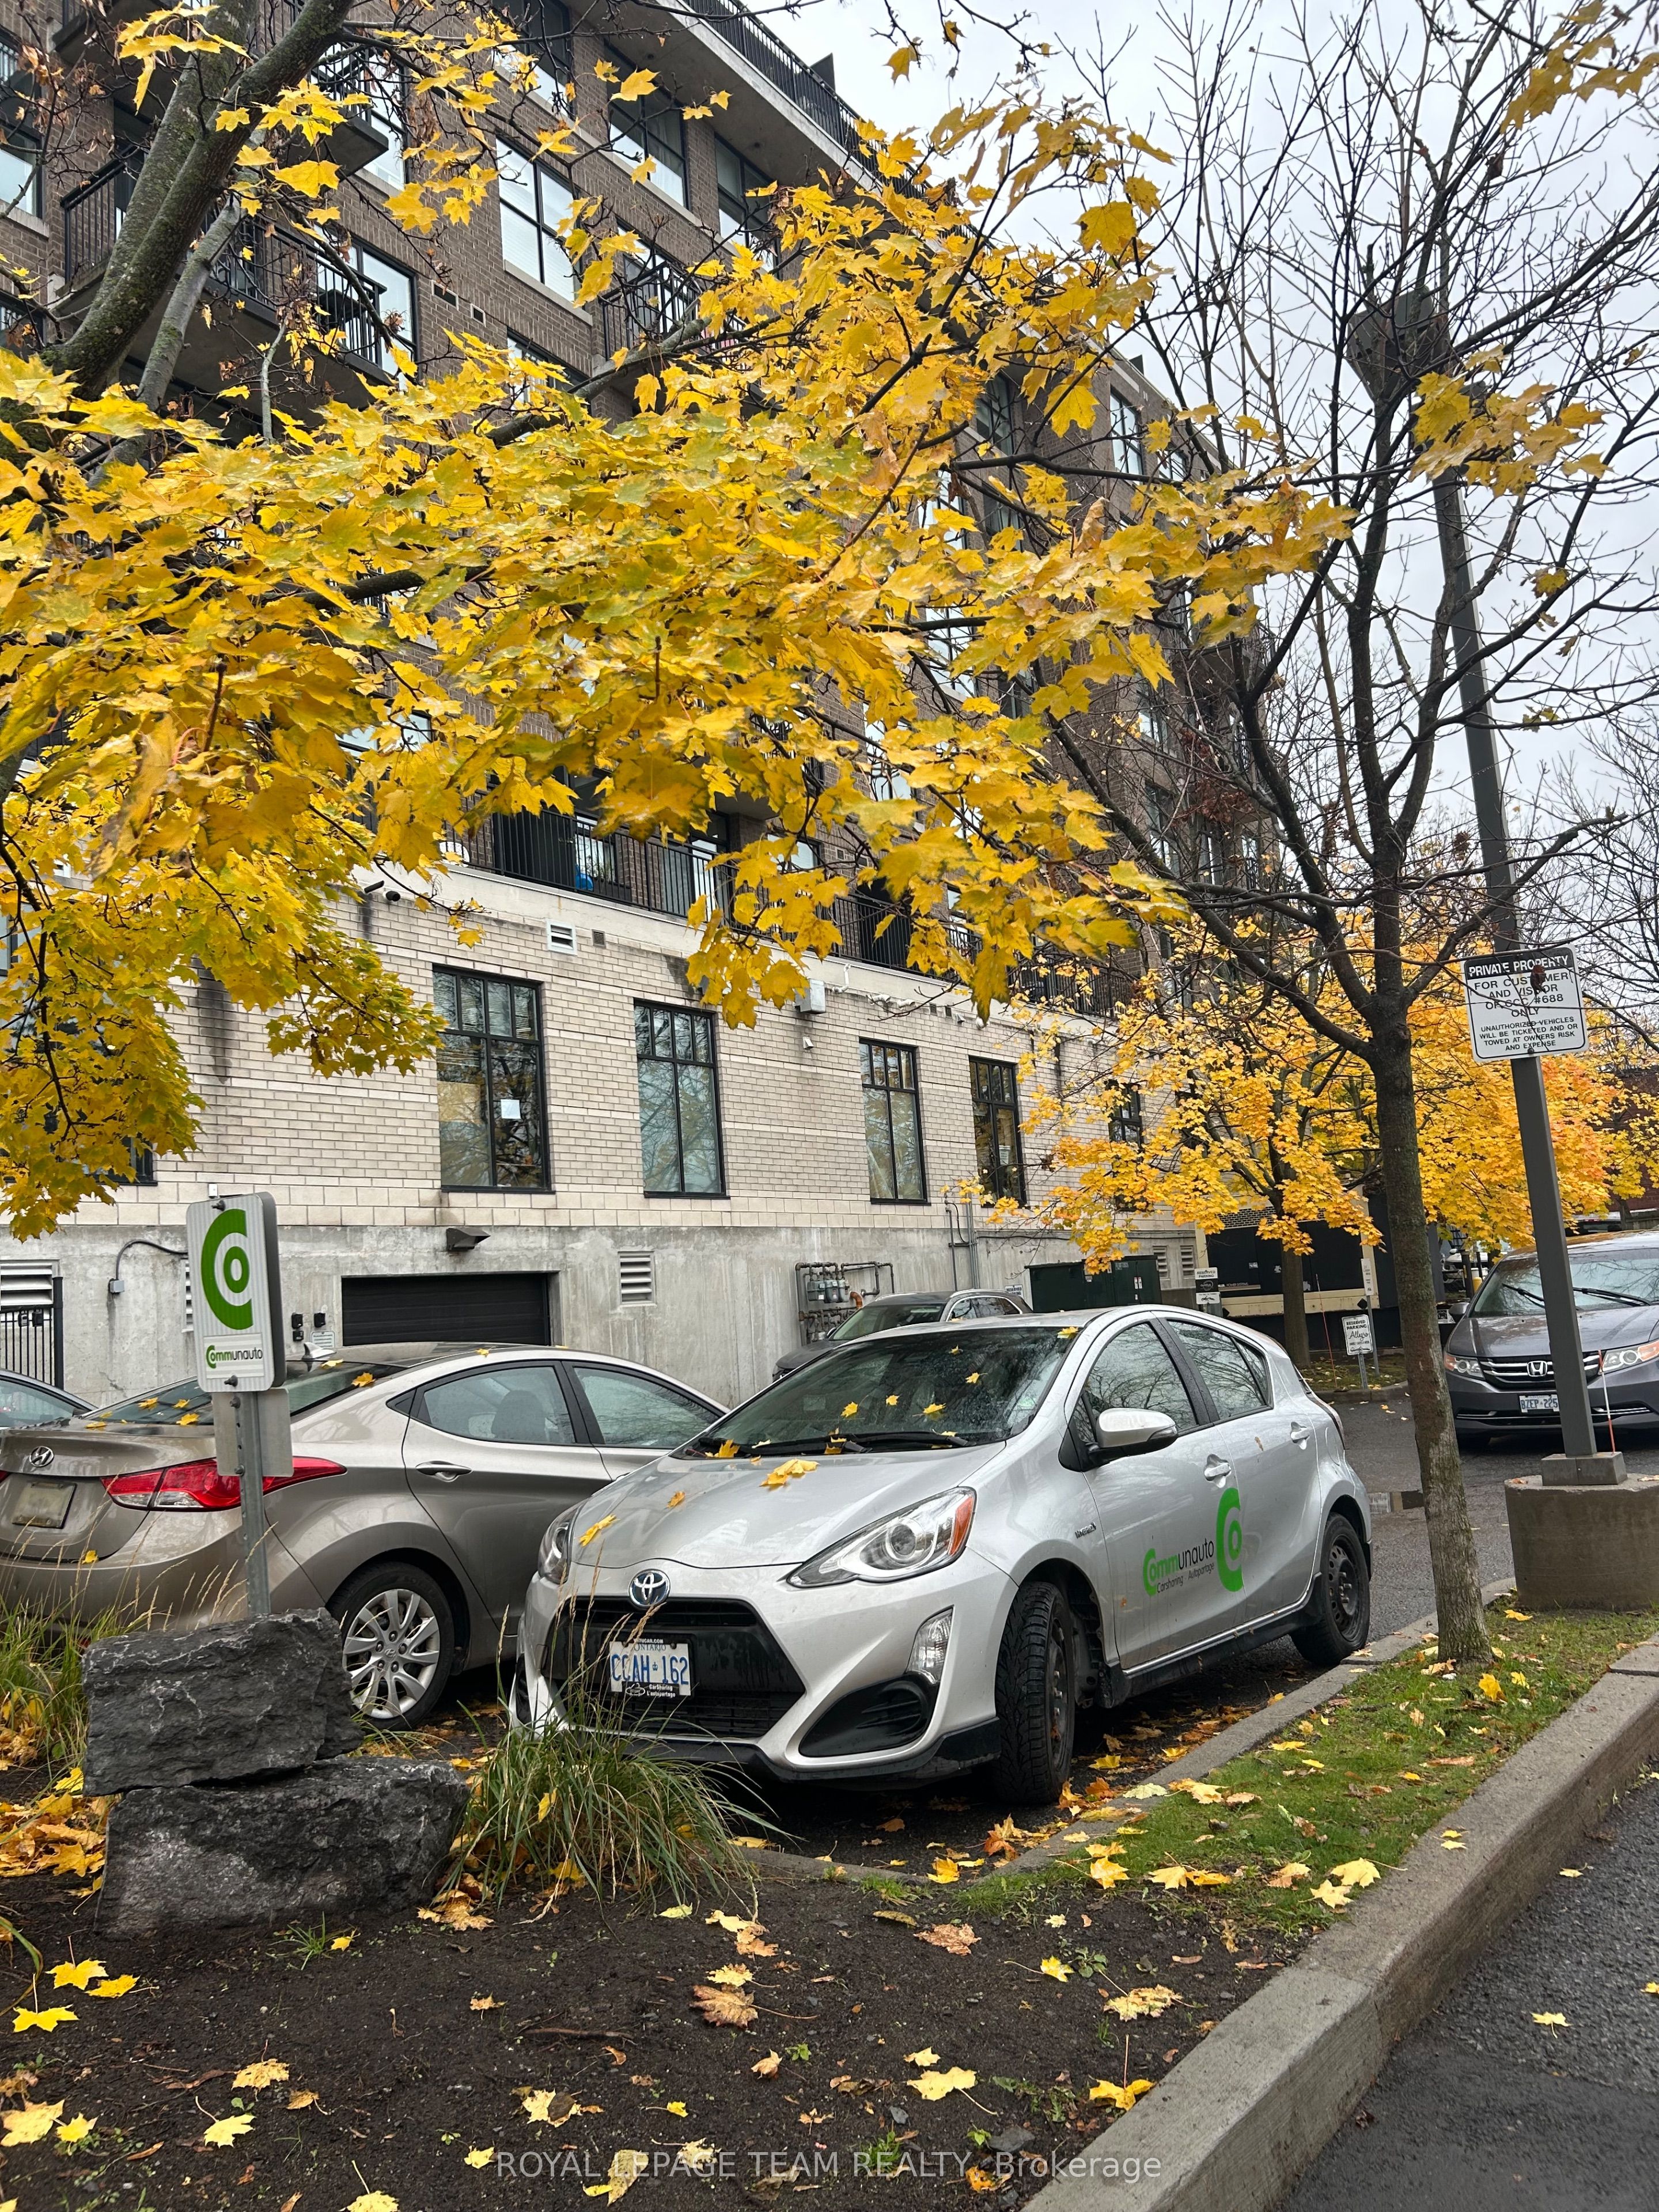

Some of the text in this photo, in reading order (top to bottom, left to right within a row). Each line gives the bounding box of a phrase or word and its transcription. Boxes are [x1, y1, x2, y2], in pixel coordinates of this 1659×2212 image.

[1469, 955, 1569, 977] PRIVATE PROPERTY
[1474, 972, 1569, 990] FOR CUSMER
[1490, 984, 1558, 998] AND VISOR
[1535, 994, 1564, 1004] #688
[1512, 1007, 1539, 1017] ONLY
[1481, 1016, 1574, 1032] UNAUTHORIZED VEHICLES
[1512, 1027, 1547, 1035] TICKETED
[1524, 1033, 1555, 1041] OWNERS
[1523, 1040, 1556, 1049] EXPENSE
[1348, 1330, 1369, 1342] Allegro
[206, 1345, 263, 1369] Communauto
[1543, 1398, 1558, 1408] 225
[1143, 1538, 1214, 1596] Communauto
[1157, 1562, 1215, 1593] Carsharing Autopartage
[634, 1643, 666, 1652] ONTARIO
[611, 1654, 689, 1685] CCAH 162
